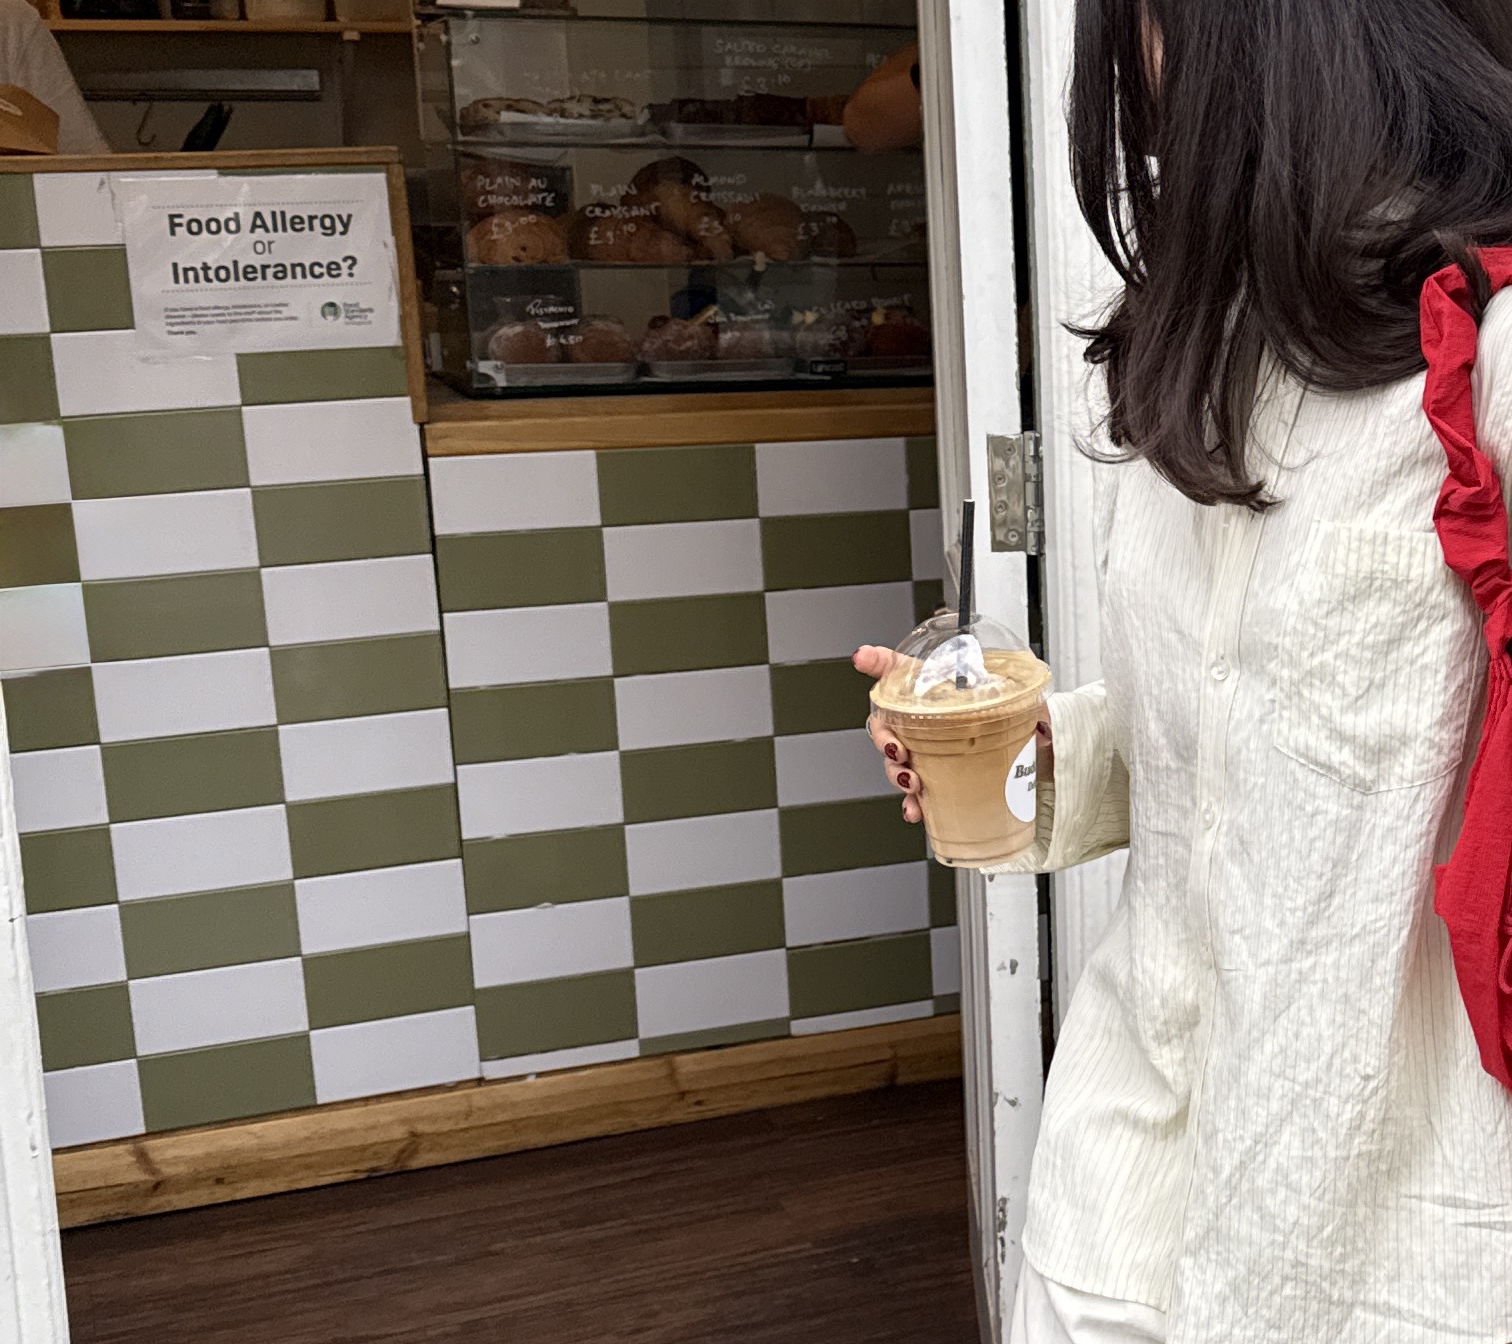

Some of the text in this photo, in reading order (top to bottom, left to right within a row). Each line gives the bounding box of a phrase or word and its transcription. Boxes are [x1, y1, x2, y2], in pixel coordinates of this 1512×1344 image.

[476, 174, 548, 191] PLAIN AU
[167, 210, 353, 237] Food Allergy
[252, 239, 275, 255] or
[171, 255, 358, 285] Intolerance?
